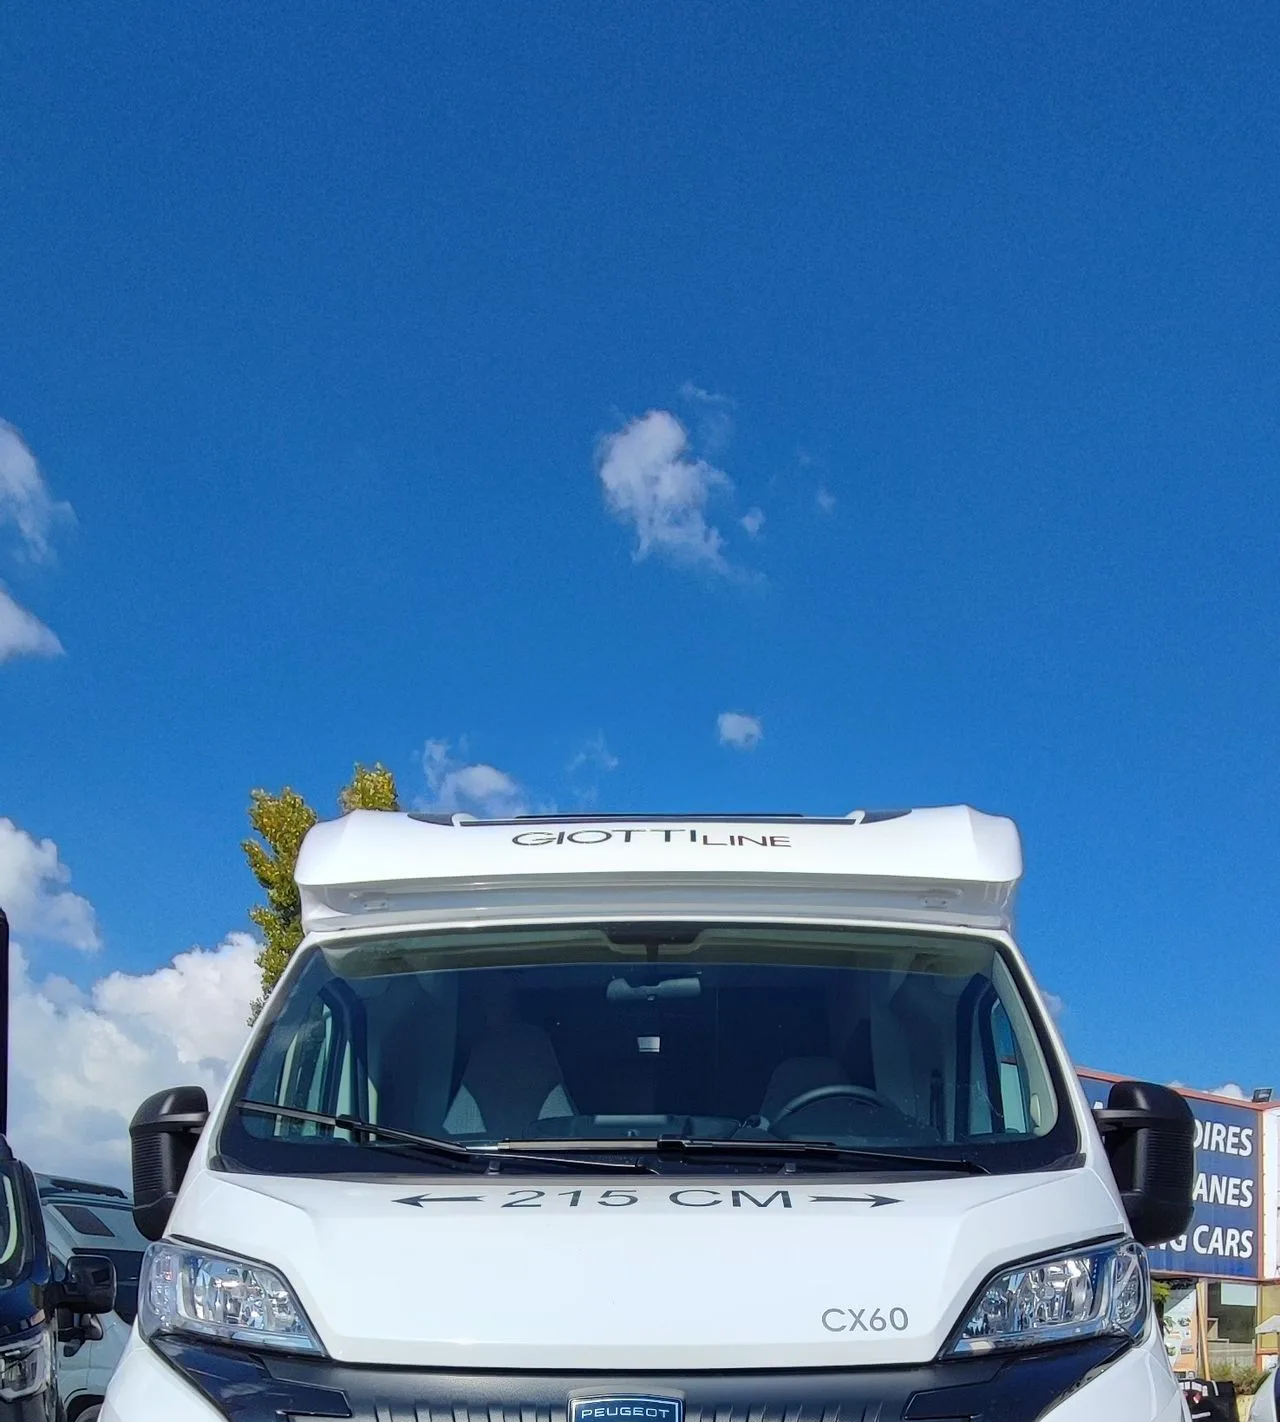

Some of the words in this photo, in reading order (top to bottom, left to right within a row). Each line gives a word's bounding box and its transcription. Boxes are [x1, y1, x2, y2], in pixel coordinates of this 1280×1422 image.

[511, 829, 792, 848] GIOTTILINE
[500, 1189, 639, 1208] 215
[669, 1189, 793, 1209] CM
[1192, 1172, 1254, 1208] ANES
[1192, 1224, 1254, 1259] CARS
[821, 1306, 909, 1332] CX60
[581, 1406, 670, 1419] PEUGEOT
